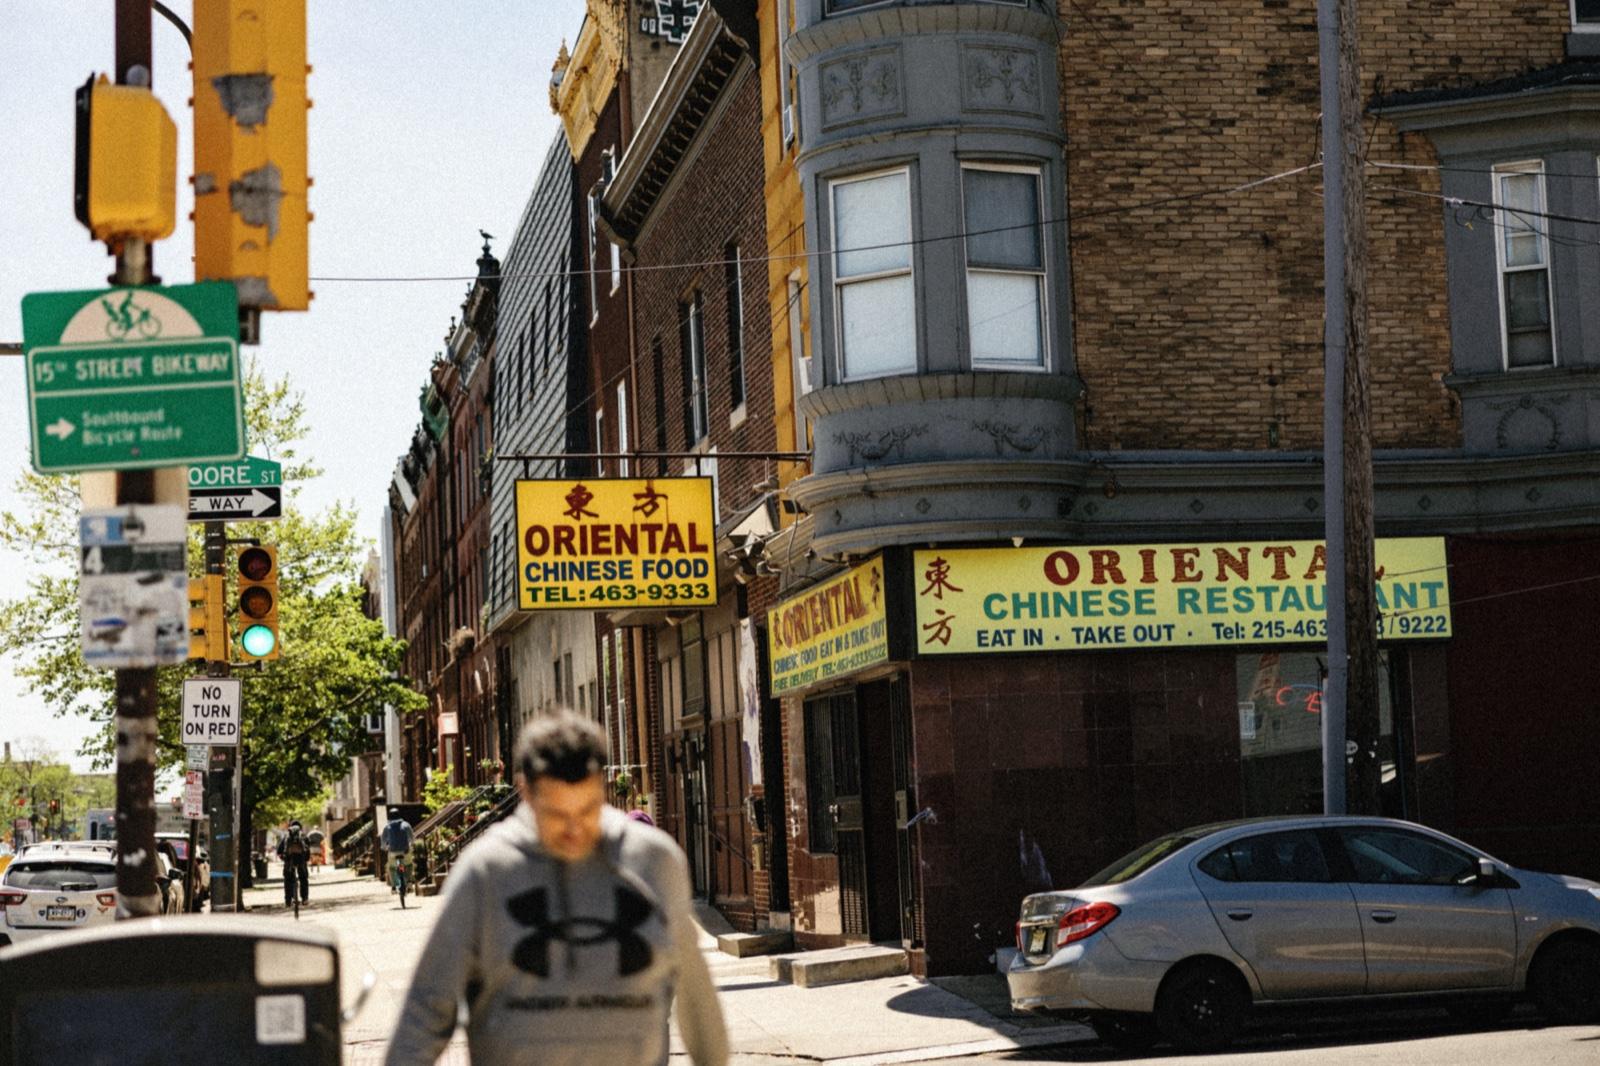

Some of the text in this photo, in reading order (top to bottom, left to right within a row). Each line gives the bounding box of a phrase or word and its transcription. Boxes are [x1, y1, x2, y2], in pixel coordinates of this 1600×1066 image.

[75, 357, 143, 382] STREET
[152, 353, 229, 376] BIKEWAY
[82, 429, 134, 447] Bicycle
[188, 466, 276, 486] OORE ST
[209, 497, 246, 511] WAY
[525, 523, 709, 557] ORIENTAL
[525, 558, 709, 583] CHINESE FOOD
[1043, 544, 1385, 587] ORIENTA
[783, 574, 869, 648] ORIENTAL
[983, 588, 1156, 620] CHINESE
[977, 629, 1043, 648] EAT IN
[1072, 624, 1175, 645] TAKE OUT
[1212, 621, 1245, 640] Tel:
[801, 645, 818, 667] FOOD
[820, 639, 834, 659] EAT
[851, 625, 869, 648] TAKE
[871, 618, 885, 642] OUT
[202, 686, 222, 700] NO
[193, 704, 231, 718] TURN
[185, 722, 236, 736] ON RED
